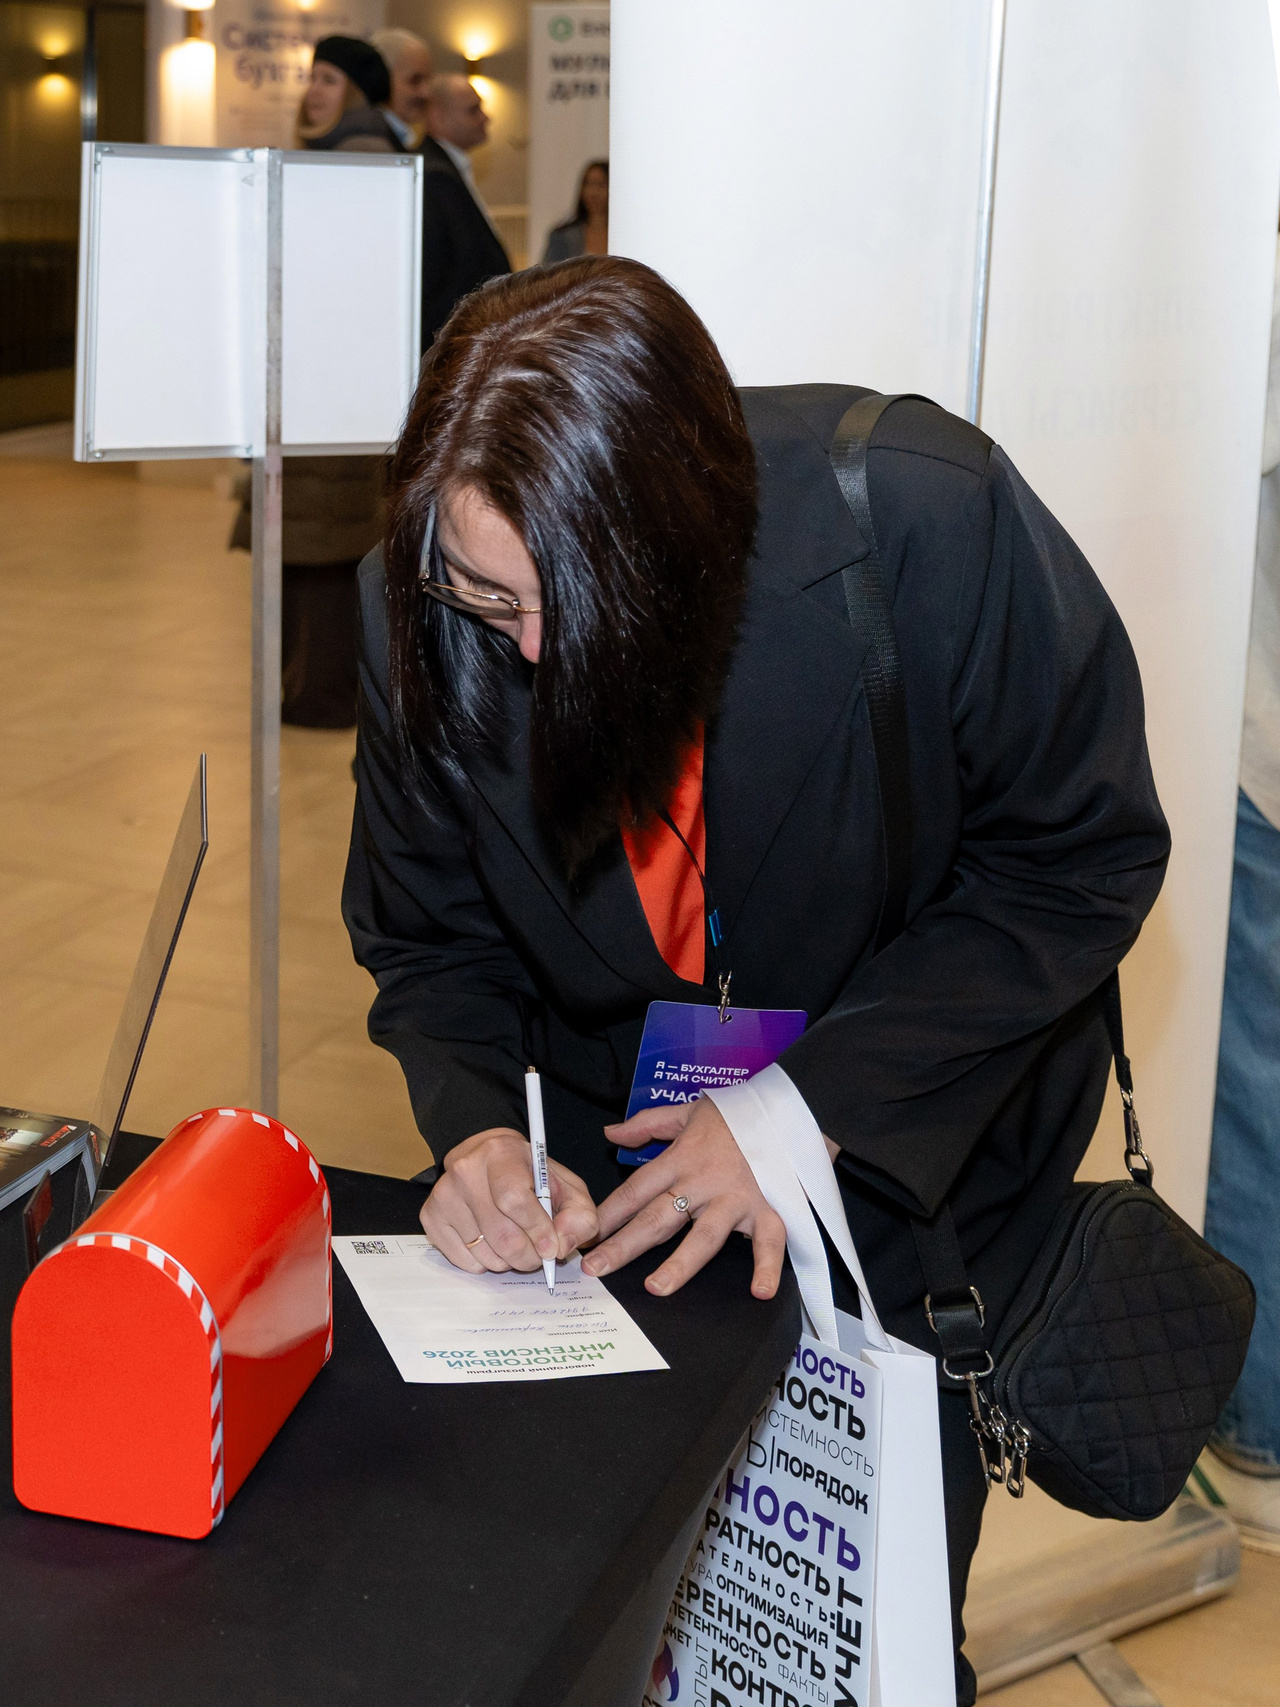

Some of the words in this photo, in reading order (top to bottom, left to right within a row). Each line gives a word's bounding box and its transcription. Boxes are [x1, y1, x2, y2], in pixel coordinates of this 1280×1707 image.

[653, 1071, 664, 1079] Я
[665, 1072, 689, 1082] ТАК
[656, 1061, 665, 1069] Я
[680, 1064, 750, 1077] БУХГАЛТЕР
[422, 1350, 478, 1359] 2026
[484, 1342, 616, 1358] ИНТЕНСИВ
[446, 1352, 605, 1370] НАЛОГОВЫЙ
[528, 1363, 595, 1373] новогодний
[466, 1367, 526, 1375] розыгрыш
[776, 1447, 869, 1515] ПОРЯДОК
[714, 1467, 861, 1572] НОСТЬ
[705, 1507, 831, 1596] РАТНОСТЬ
[716, 1573, 829, 1650] ОПТИМИЗАЦИЯ
[711, 1647, 813, 1707] КОНТР
[778, 1663, 829, 1705] ФАКТЫ
